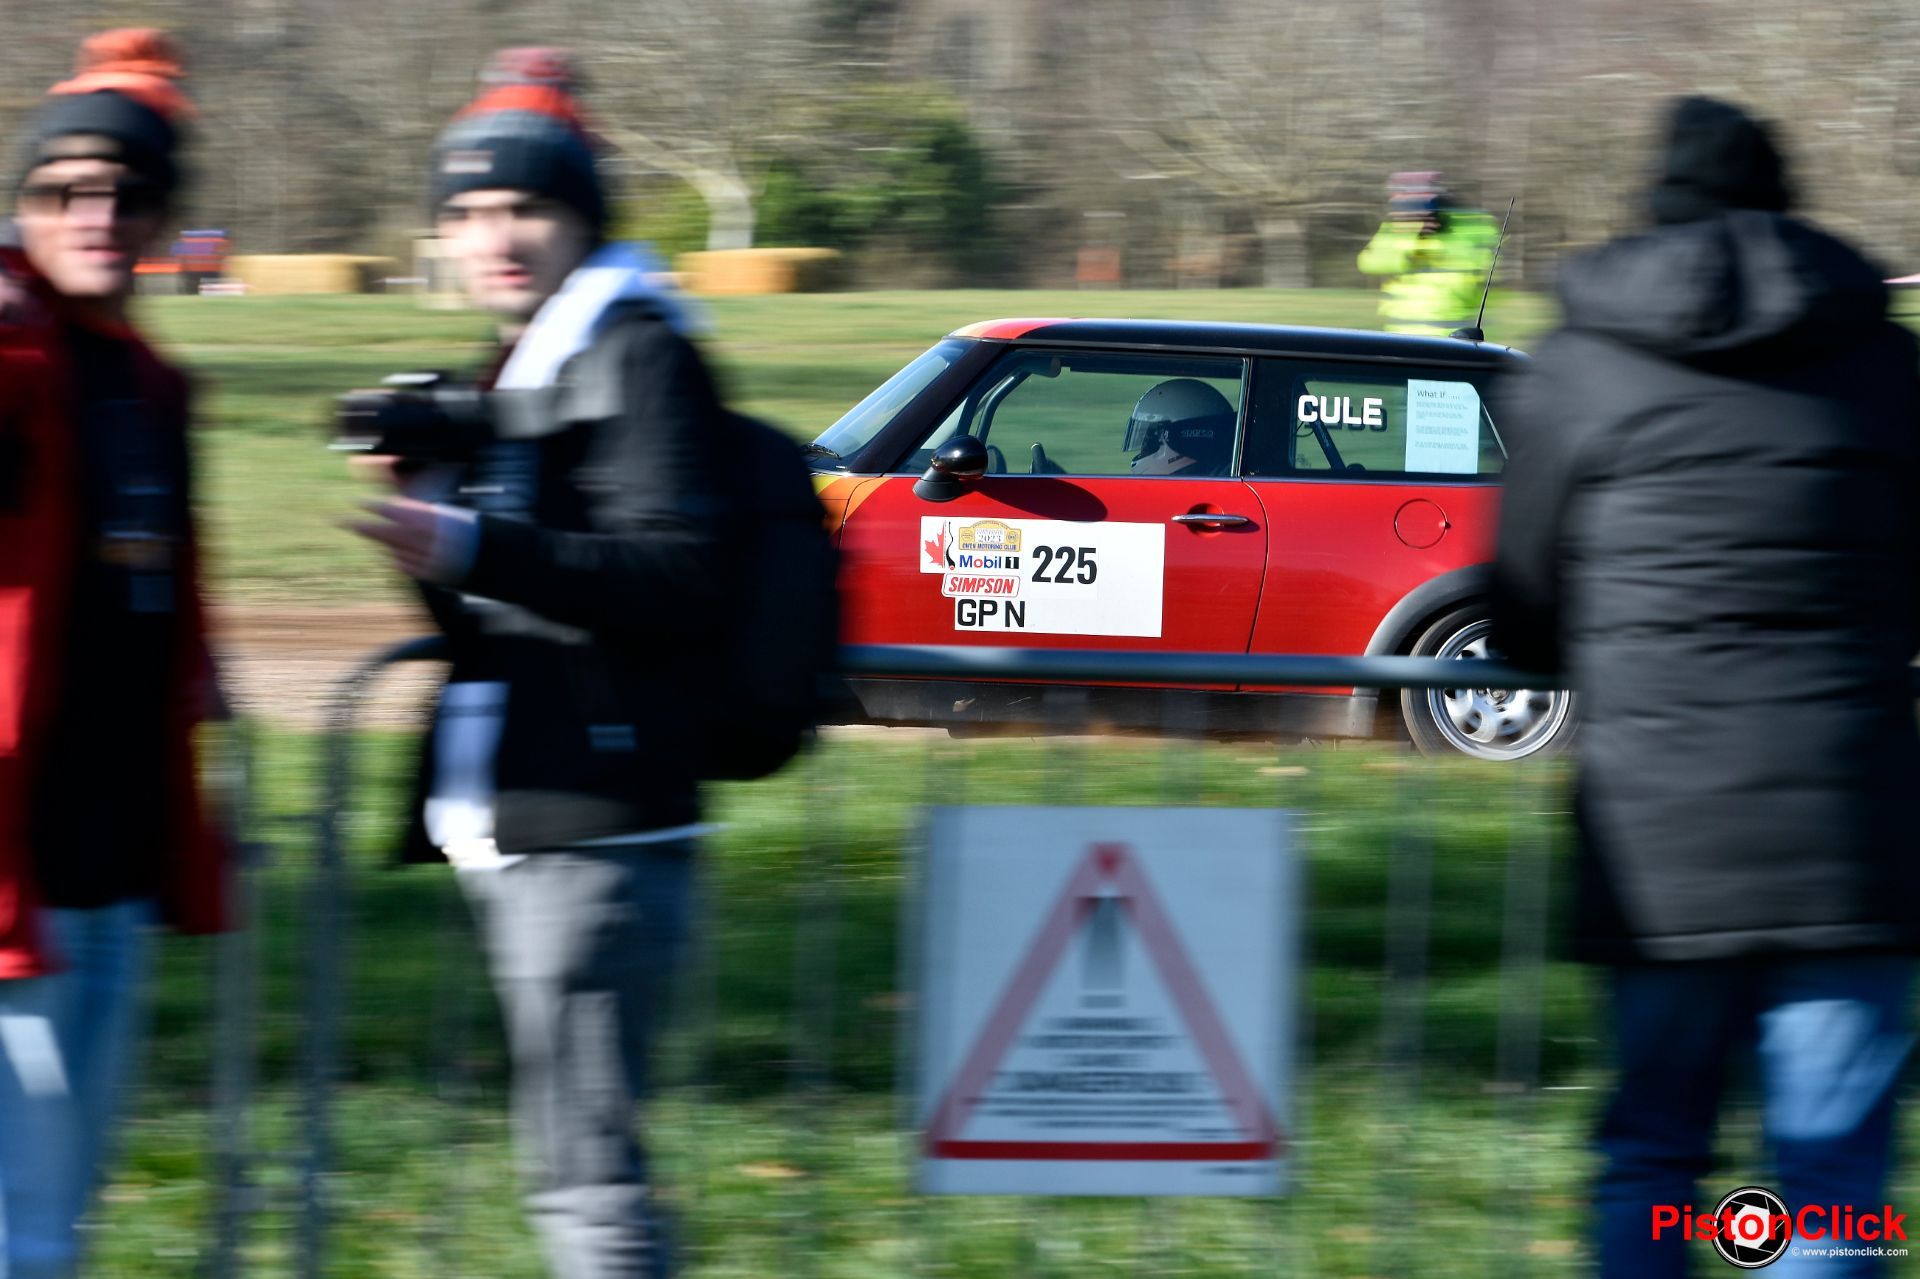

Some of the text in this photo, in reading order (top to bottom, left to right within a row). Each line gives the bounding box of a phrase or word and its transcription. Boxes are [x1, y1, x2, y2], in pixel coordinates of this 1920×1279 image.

[1416, 389, 1437, 399] What
[1297, 394, 1383, 426] CULE
[959, 554, 1020, 569] Mobil 1
[1031, 545, 1098, 585] 225
[948, 576, 1015, 594] SIMPSON
[957, 599, 1026, 628] GP N
